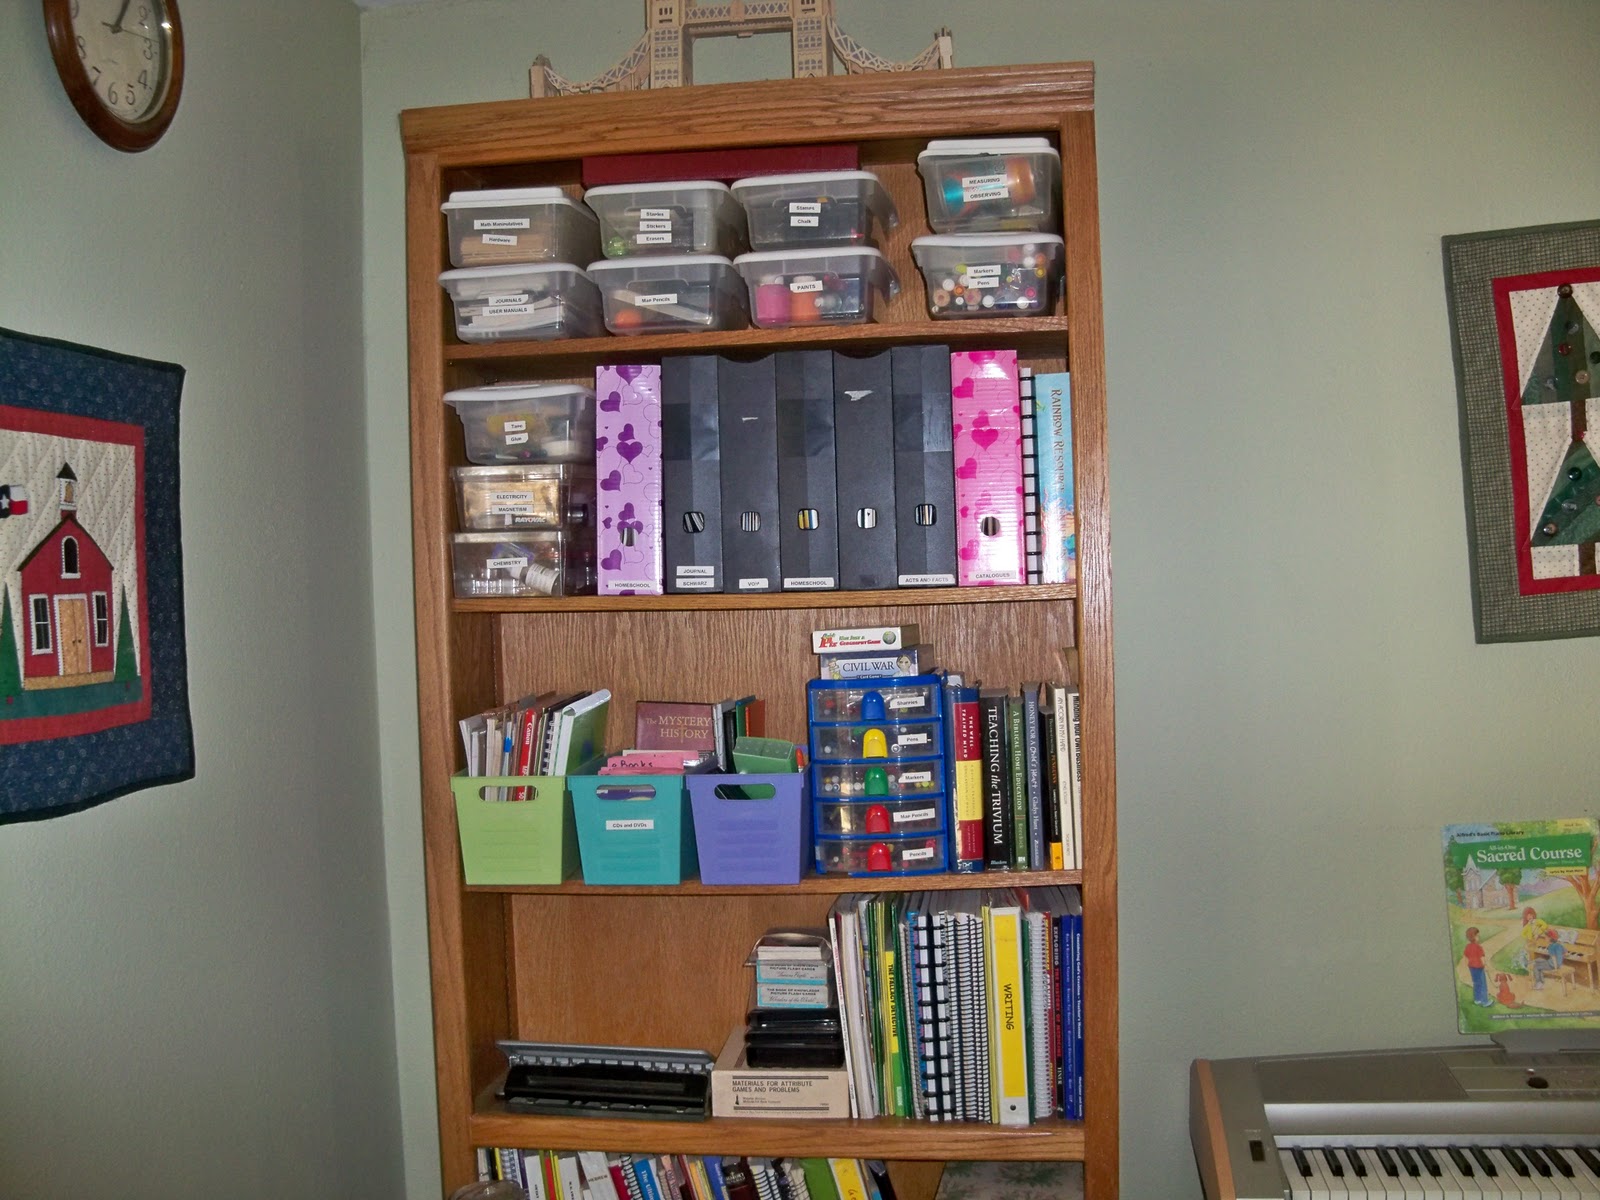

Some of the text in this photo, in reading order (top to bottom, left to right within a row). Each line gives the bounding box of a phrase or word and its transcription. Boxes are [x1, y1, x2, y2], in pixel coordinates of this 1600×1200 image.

[143, 39, 153, 60] 3
[138, 69, 148, 90] 4
[108, 81, 118, 105] 6
[126, 83, 136, 106] 5
[968, 177, 1001, 185] MEASURING
[970, 191, 1002, 199] OBSERVING
[1051, 388, 1063, 438] RAINBOW
[514, 516, 547, 524] RAYOVAC
[492, 559, 522, 567] CHEMISTRY
[975, 572, 1010, 580] CATALOGUES
[842, 661, 895, 673] CIVIL WAR
[659, 716, 712, 727] MYSTERY
[525, 722, 533, 745] Canon
[660, 727, 709, 741] HISTORY
[988, 706, 1003, 845] TEACHING the TRIVIUM
[1031, 796, 1039, 815] Gladys
[1476, 846, 1583, 863] Sacred Course
[1004, 983, 1015, 1031] WRITING
[641, 1169, 649, 1183] The
